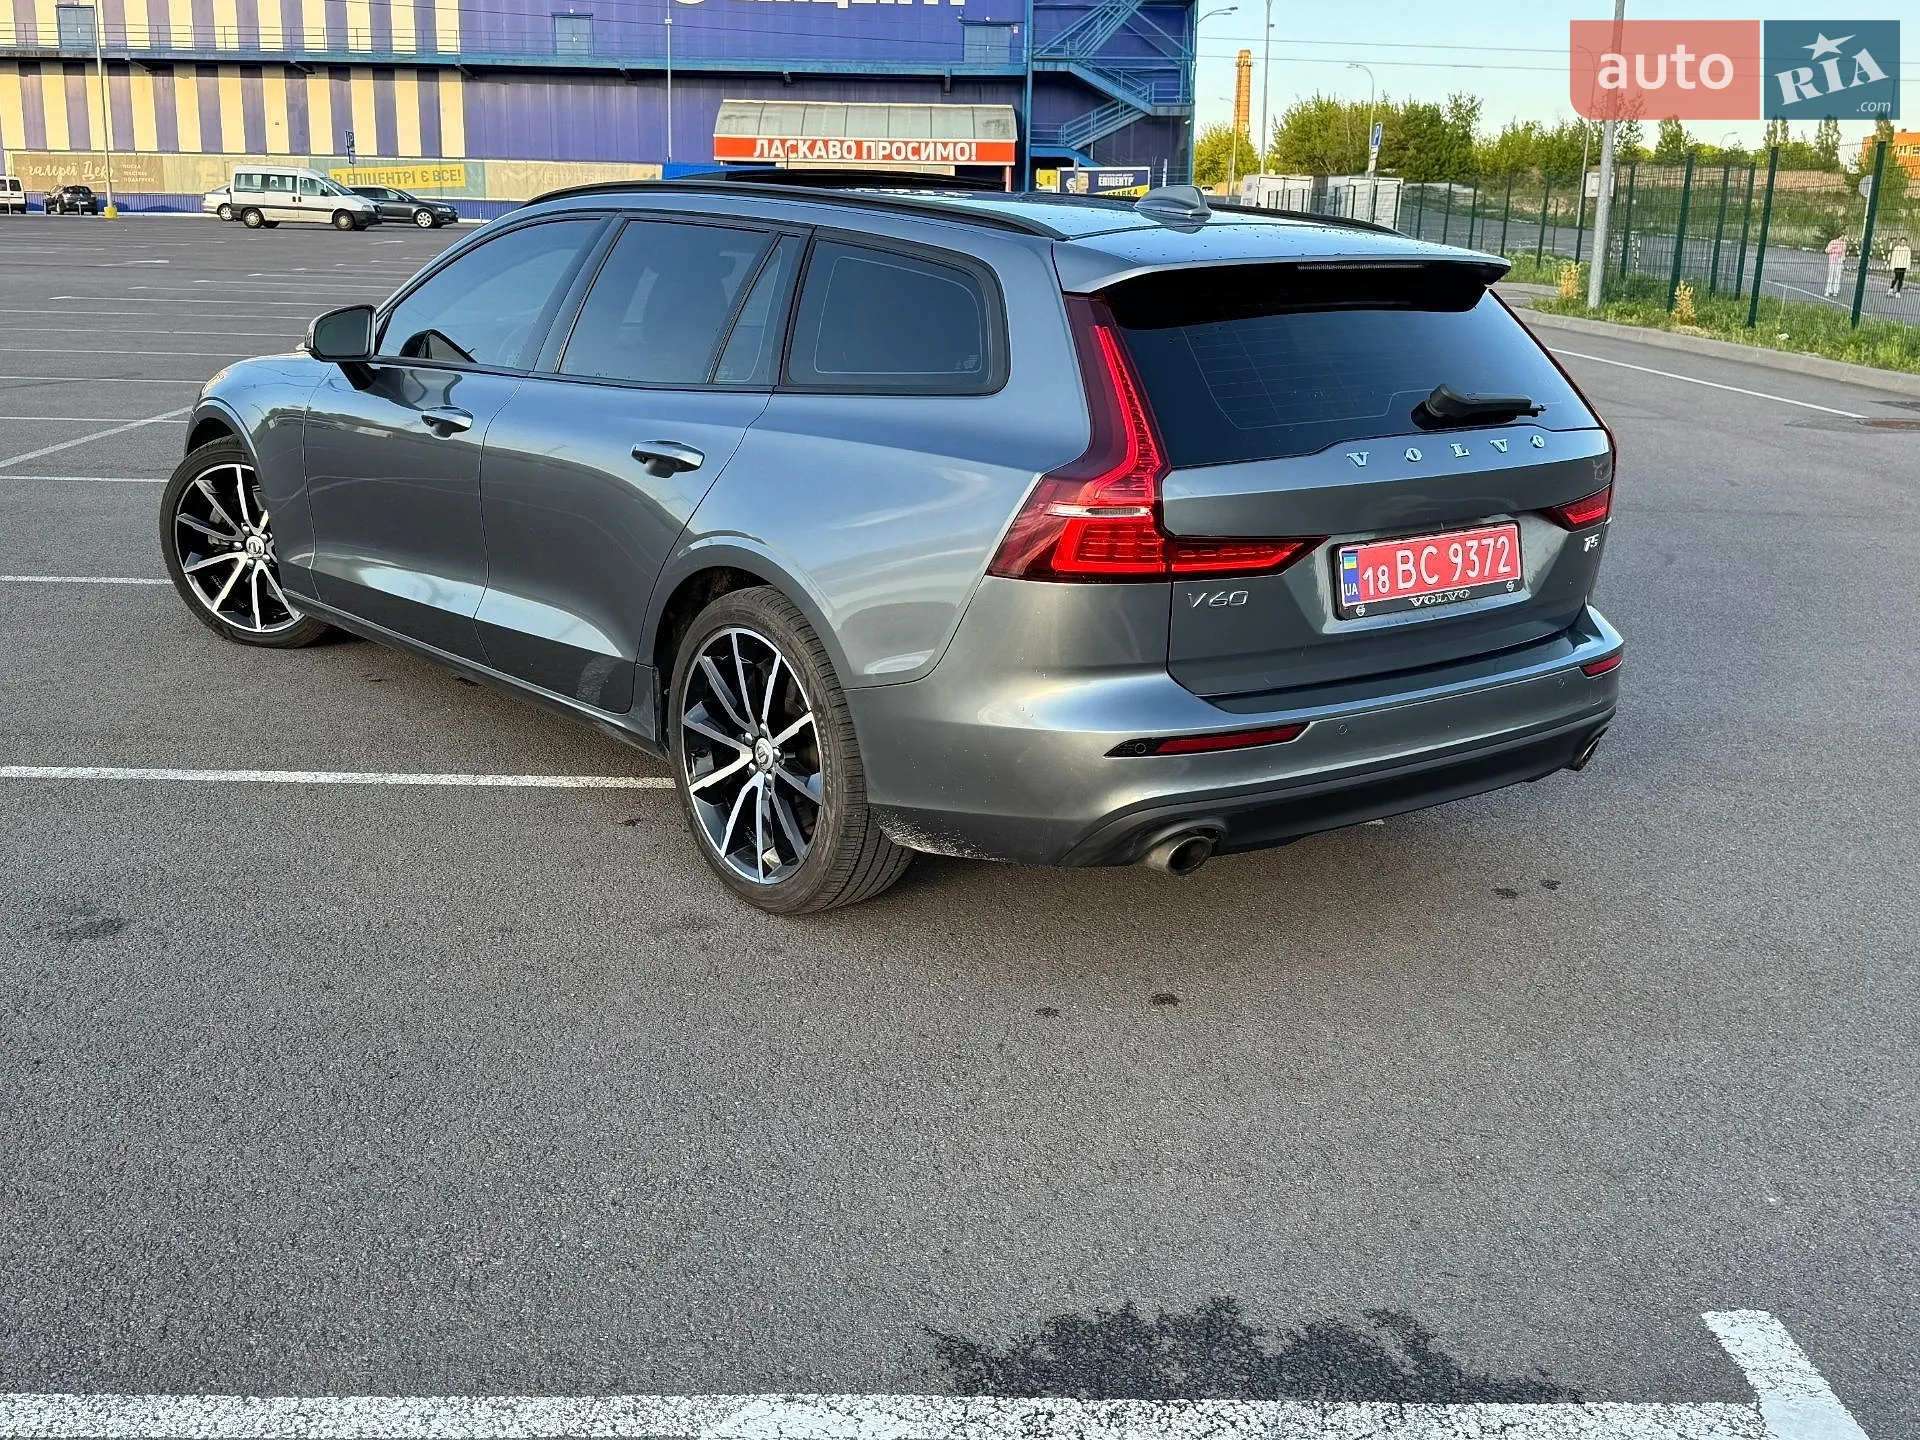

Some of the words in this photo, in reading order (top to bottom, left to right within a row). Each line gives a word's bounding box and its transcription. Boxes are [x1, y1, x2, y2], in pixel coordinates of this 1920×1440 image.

[753, 139, 856, 160] ЛАСКАВО
[863, 141, 977, 161] ПРОСИМО!
[347, 171, 416, 185] ЕПІЦЕНТРІ
[421, 170, 430, 182] Є
[432, 169, 462, 182] ВСЕ!
[1346, 434, 1545, 468] VOLVO
[1362, 565, 1391, 596] 18
[1395, 545, 1439, 590] BC
[1448, 535, 1512, 582] 9372
[1187, 590, 1249, 608] V60
[1344, 584, 1359, 597] UA
[1408, 589, 1471, 607] VOLVO
